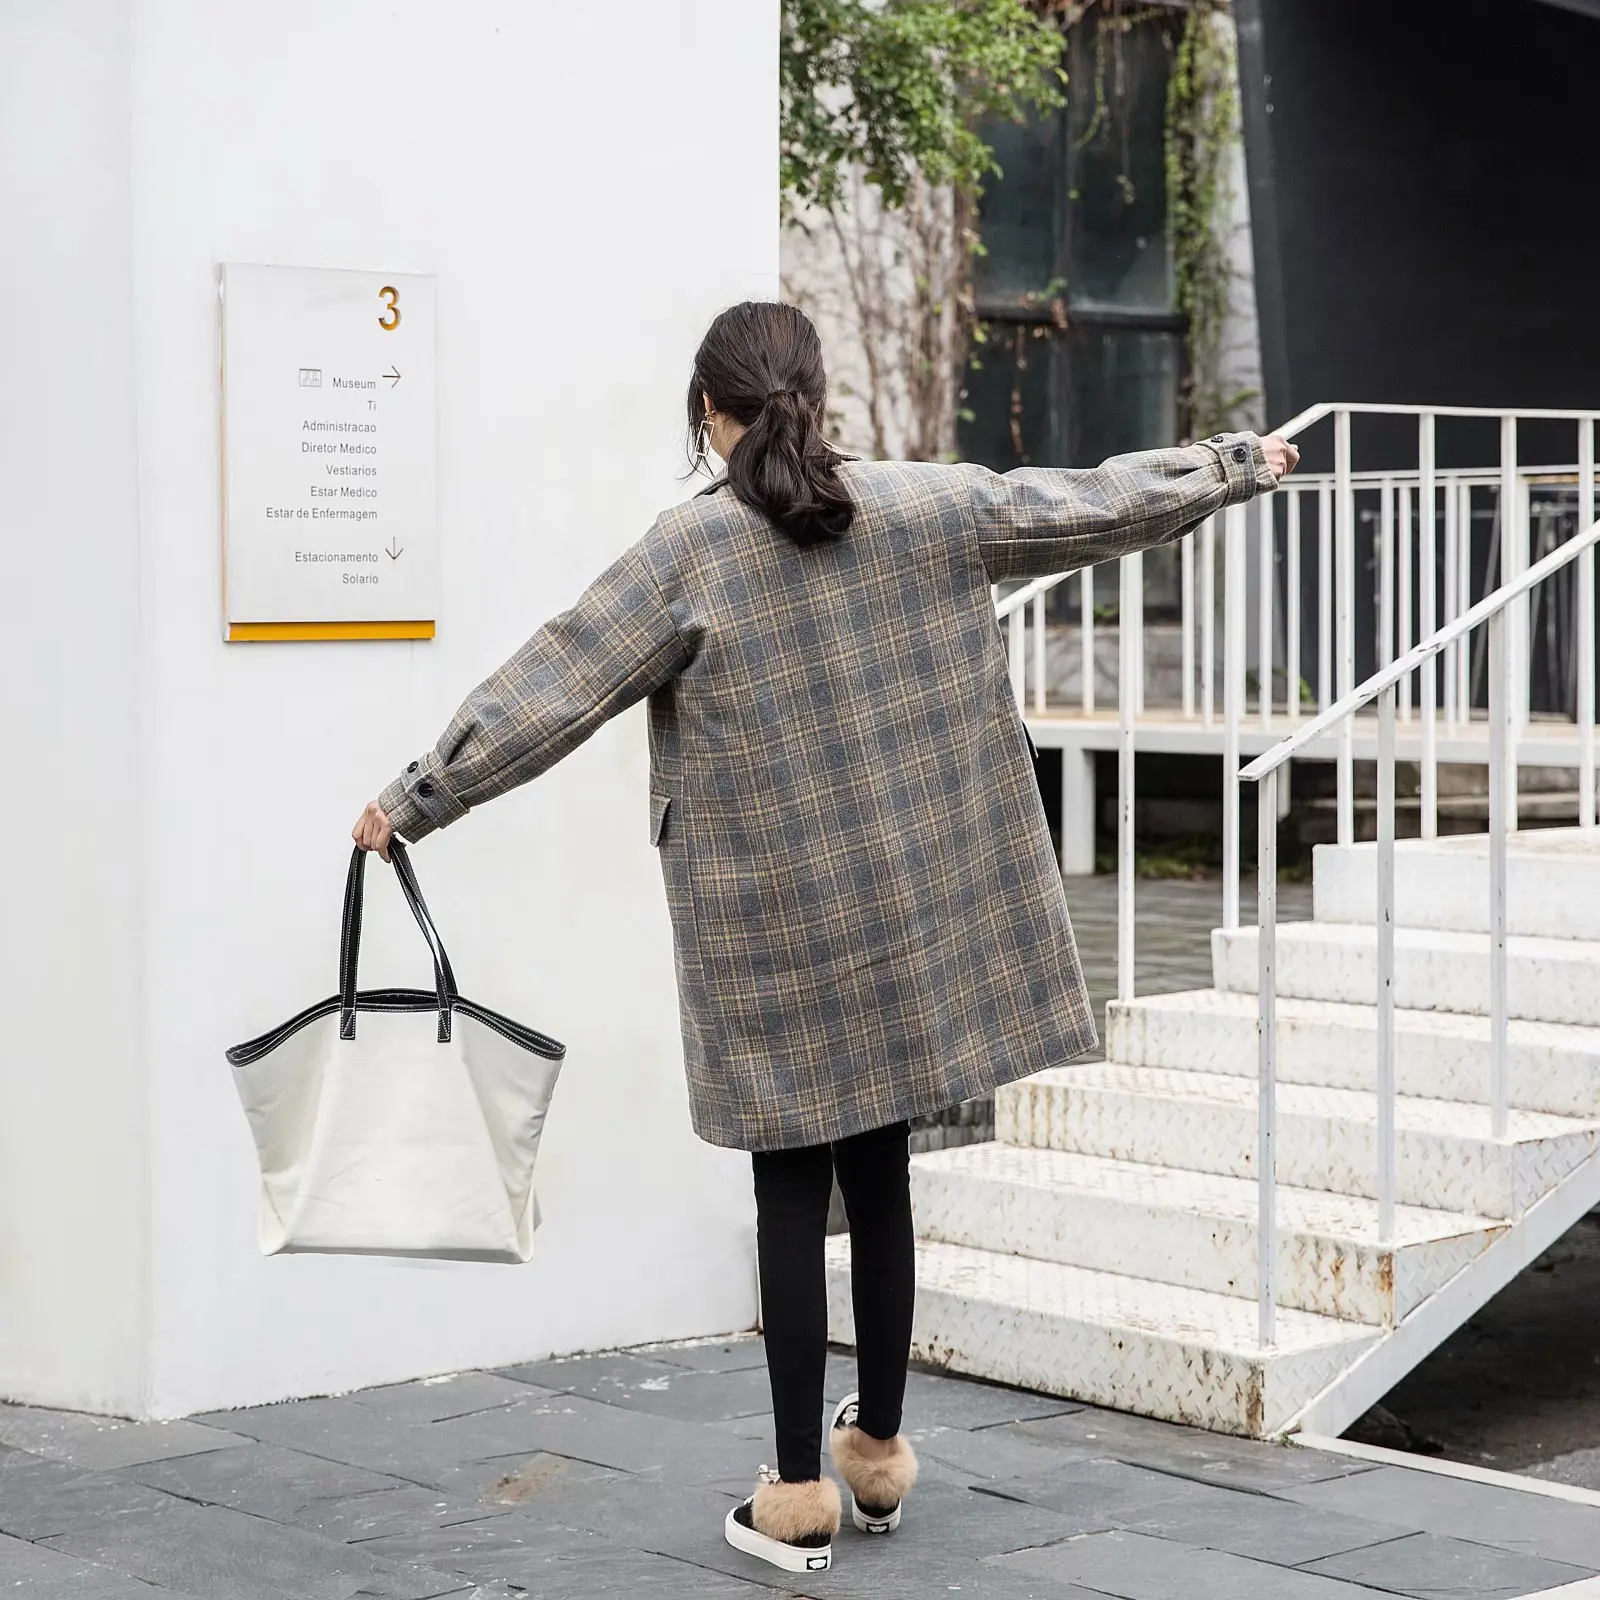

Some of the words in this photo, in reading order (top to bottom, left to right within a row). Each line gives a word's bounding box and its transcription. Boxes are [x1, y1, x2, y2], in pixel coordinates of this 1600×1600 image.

[378, 286, 401, 331] 3
[332, 377, 376, 389] Museum
[367, 400, 376, 411] Ti
[302, 420, 377, 433] Administracao
[301, 441, 337, 453] Diretor
[340, 443, 377, 455] Medico
[325, 464, 377, 477] Vestiarios
[310, 486, 338, 498] Estar
[340, 487, 378, 498] Medico
[266, 507, 294, 519] Estar
[296, 508, 309, 519] de
[312, 508, 378, 521] Enfermagem
[295, 551, 379, 563] Estacionamento
[342, 573, 379, 585] Solario
